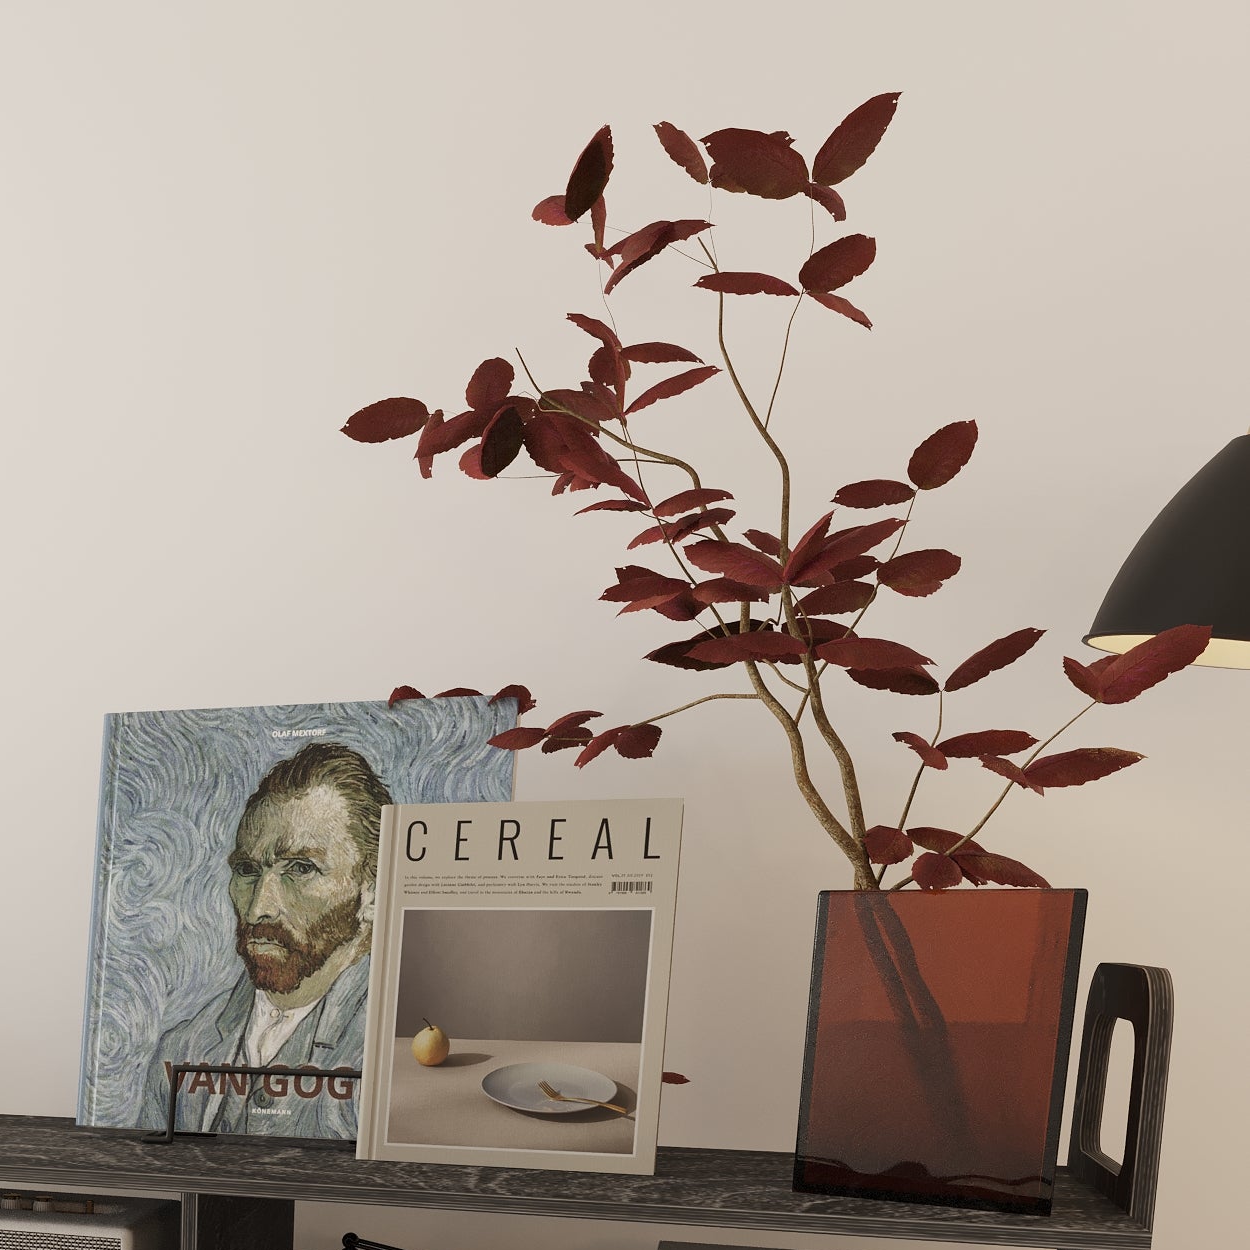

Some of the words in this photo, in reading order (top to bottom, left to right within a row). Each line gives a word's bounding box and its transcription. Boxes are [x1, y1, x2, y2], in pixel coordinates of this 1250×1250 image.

[272, 730, 291, 738] OLAF
[406, 817, 661, 861] CEREAL
[263, 1064, 361, 1100] GOG
